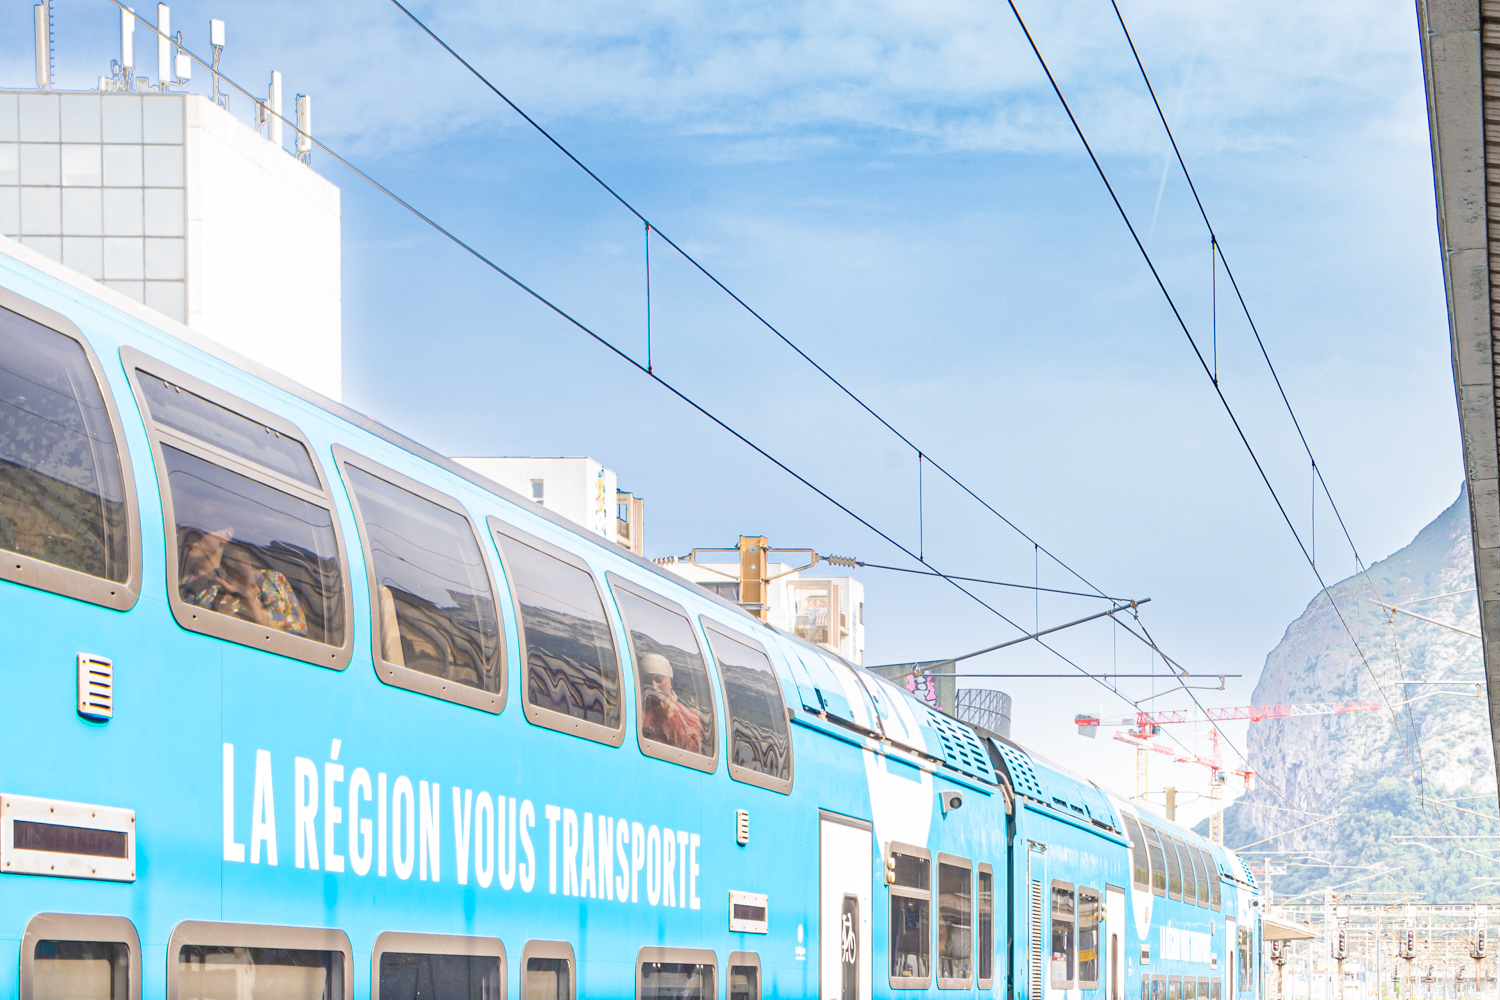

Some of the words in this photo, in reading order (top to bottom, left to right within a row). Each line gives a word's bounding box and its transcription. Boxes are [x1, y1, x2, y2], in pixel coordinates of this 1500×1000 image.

[223, 742, 278, 866] LA
[295, 738, 440, 883] RÉGION
[452, 786, 536, 892] VOUS
[545, 804, 701, 910] TRANSPORTE
